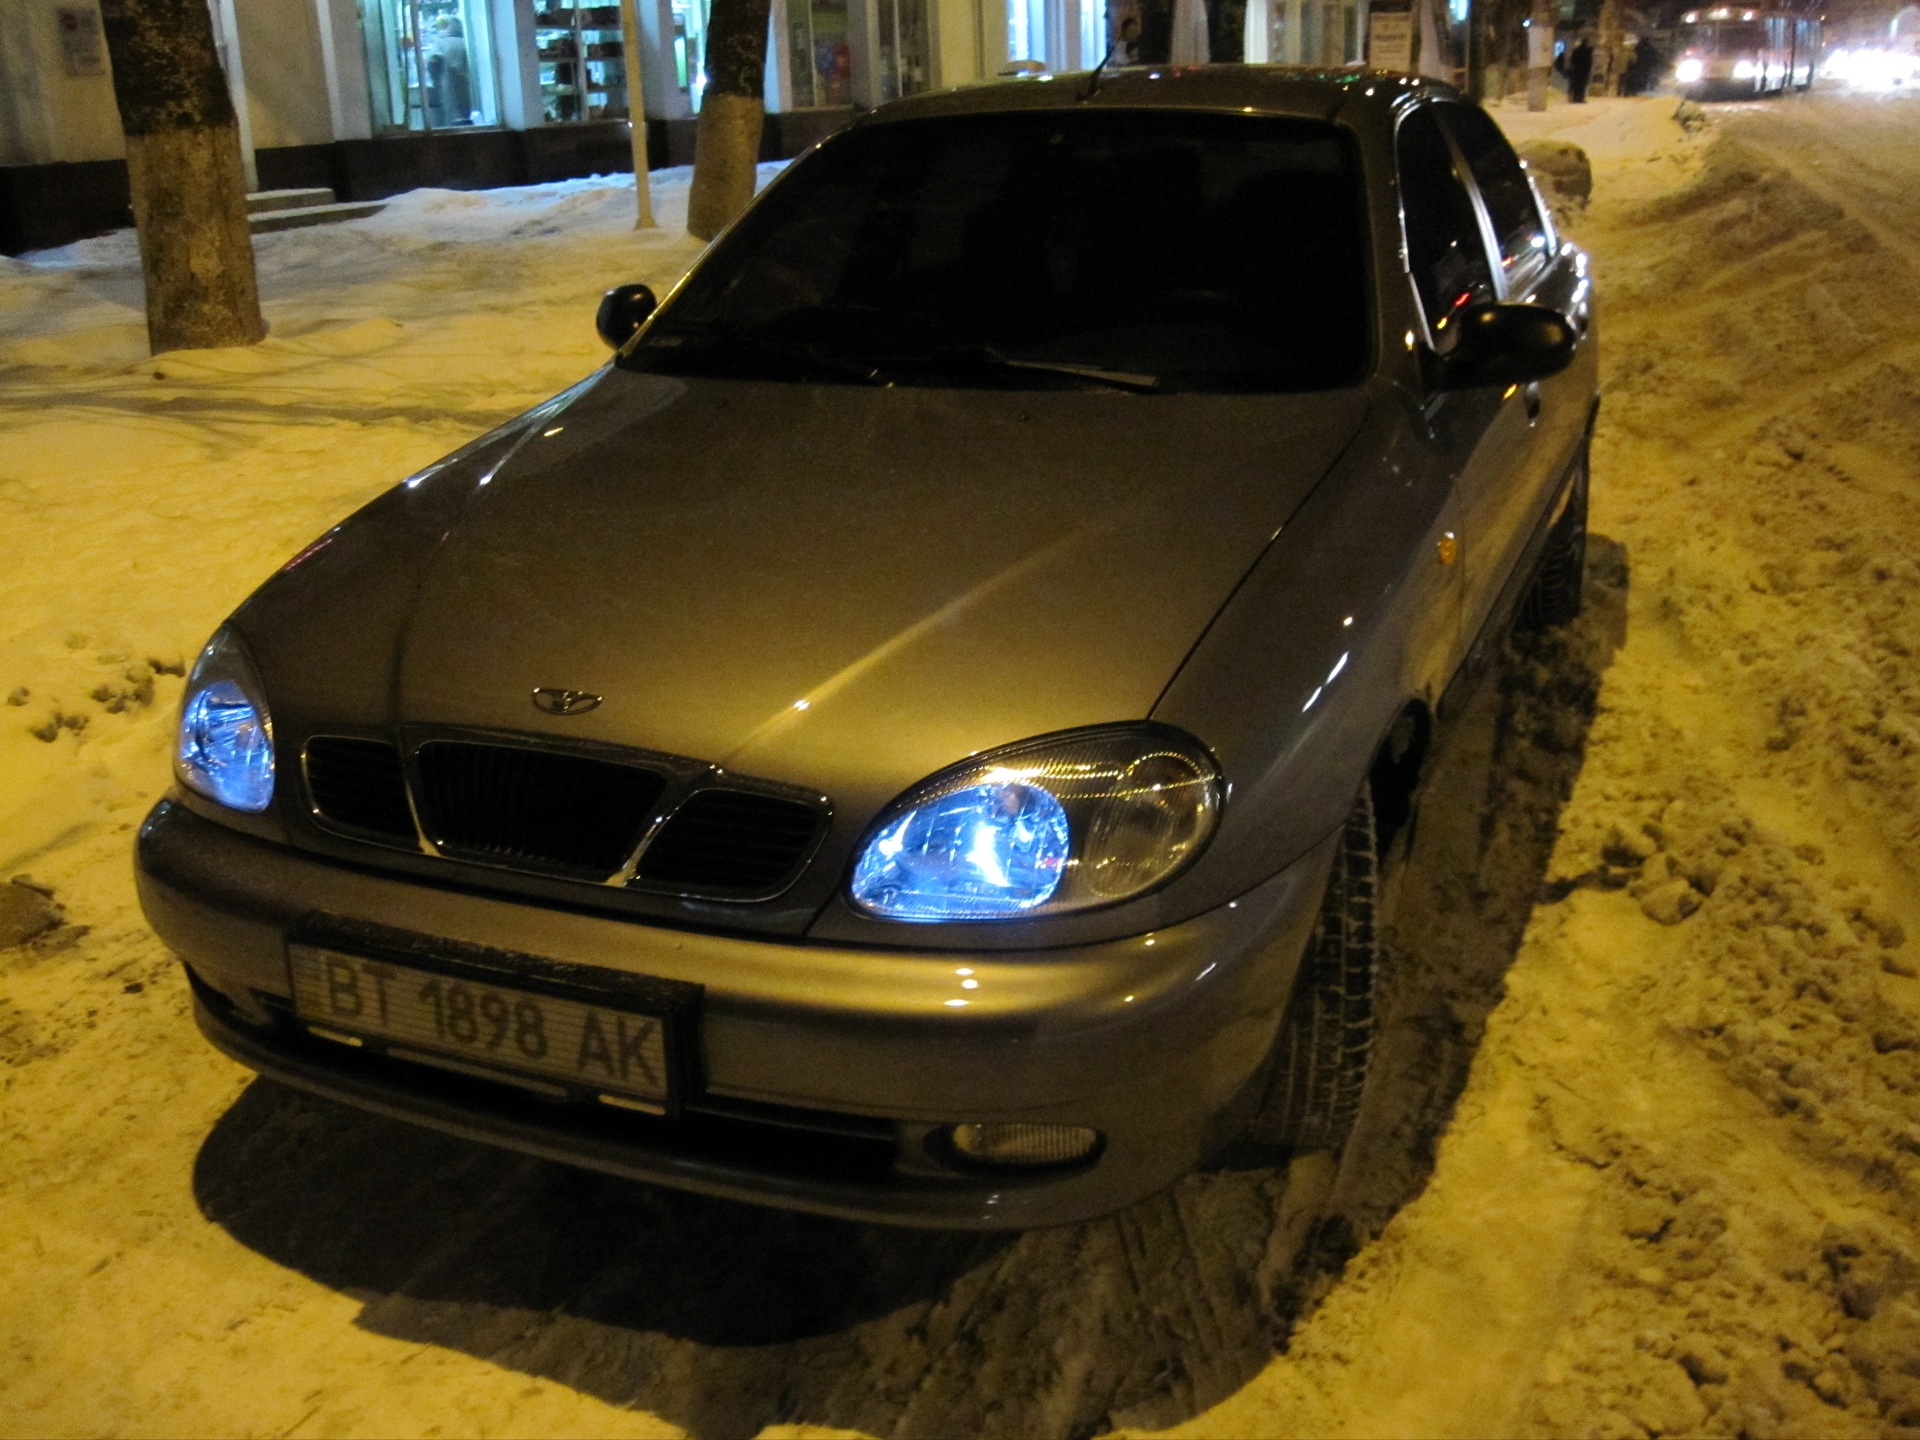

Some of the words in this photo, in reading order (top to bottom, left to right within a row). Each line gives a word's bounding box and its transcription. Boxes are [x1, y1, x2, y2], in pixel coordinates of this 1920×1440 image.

[326, 955, 396, 1026] BT
[419, 979, 548, 1059] 1898
[576, 1010, 658, 1086] AK
